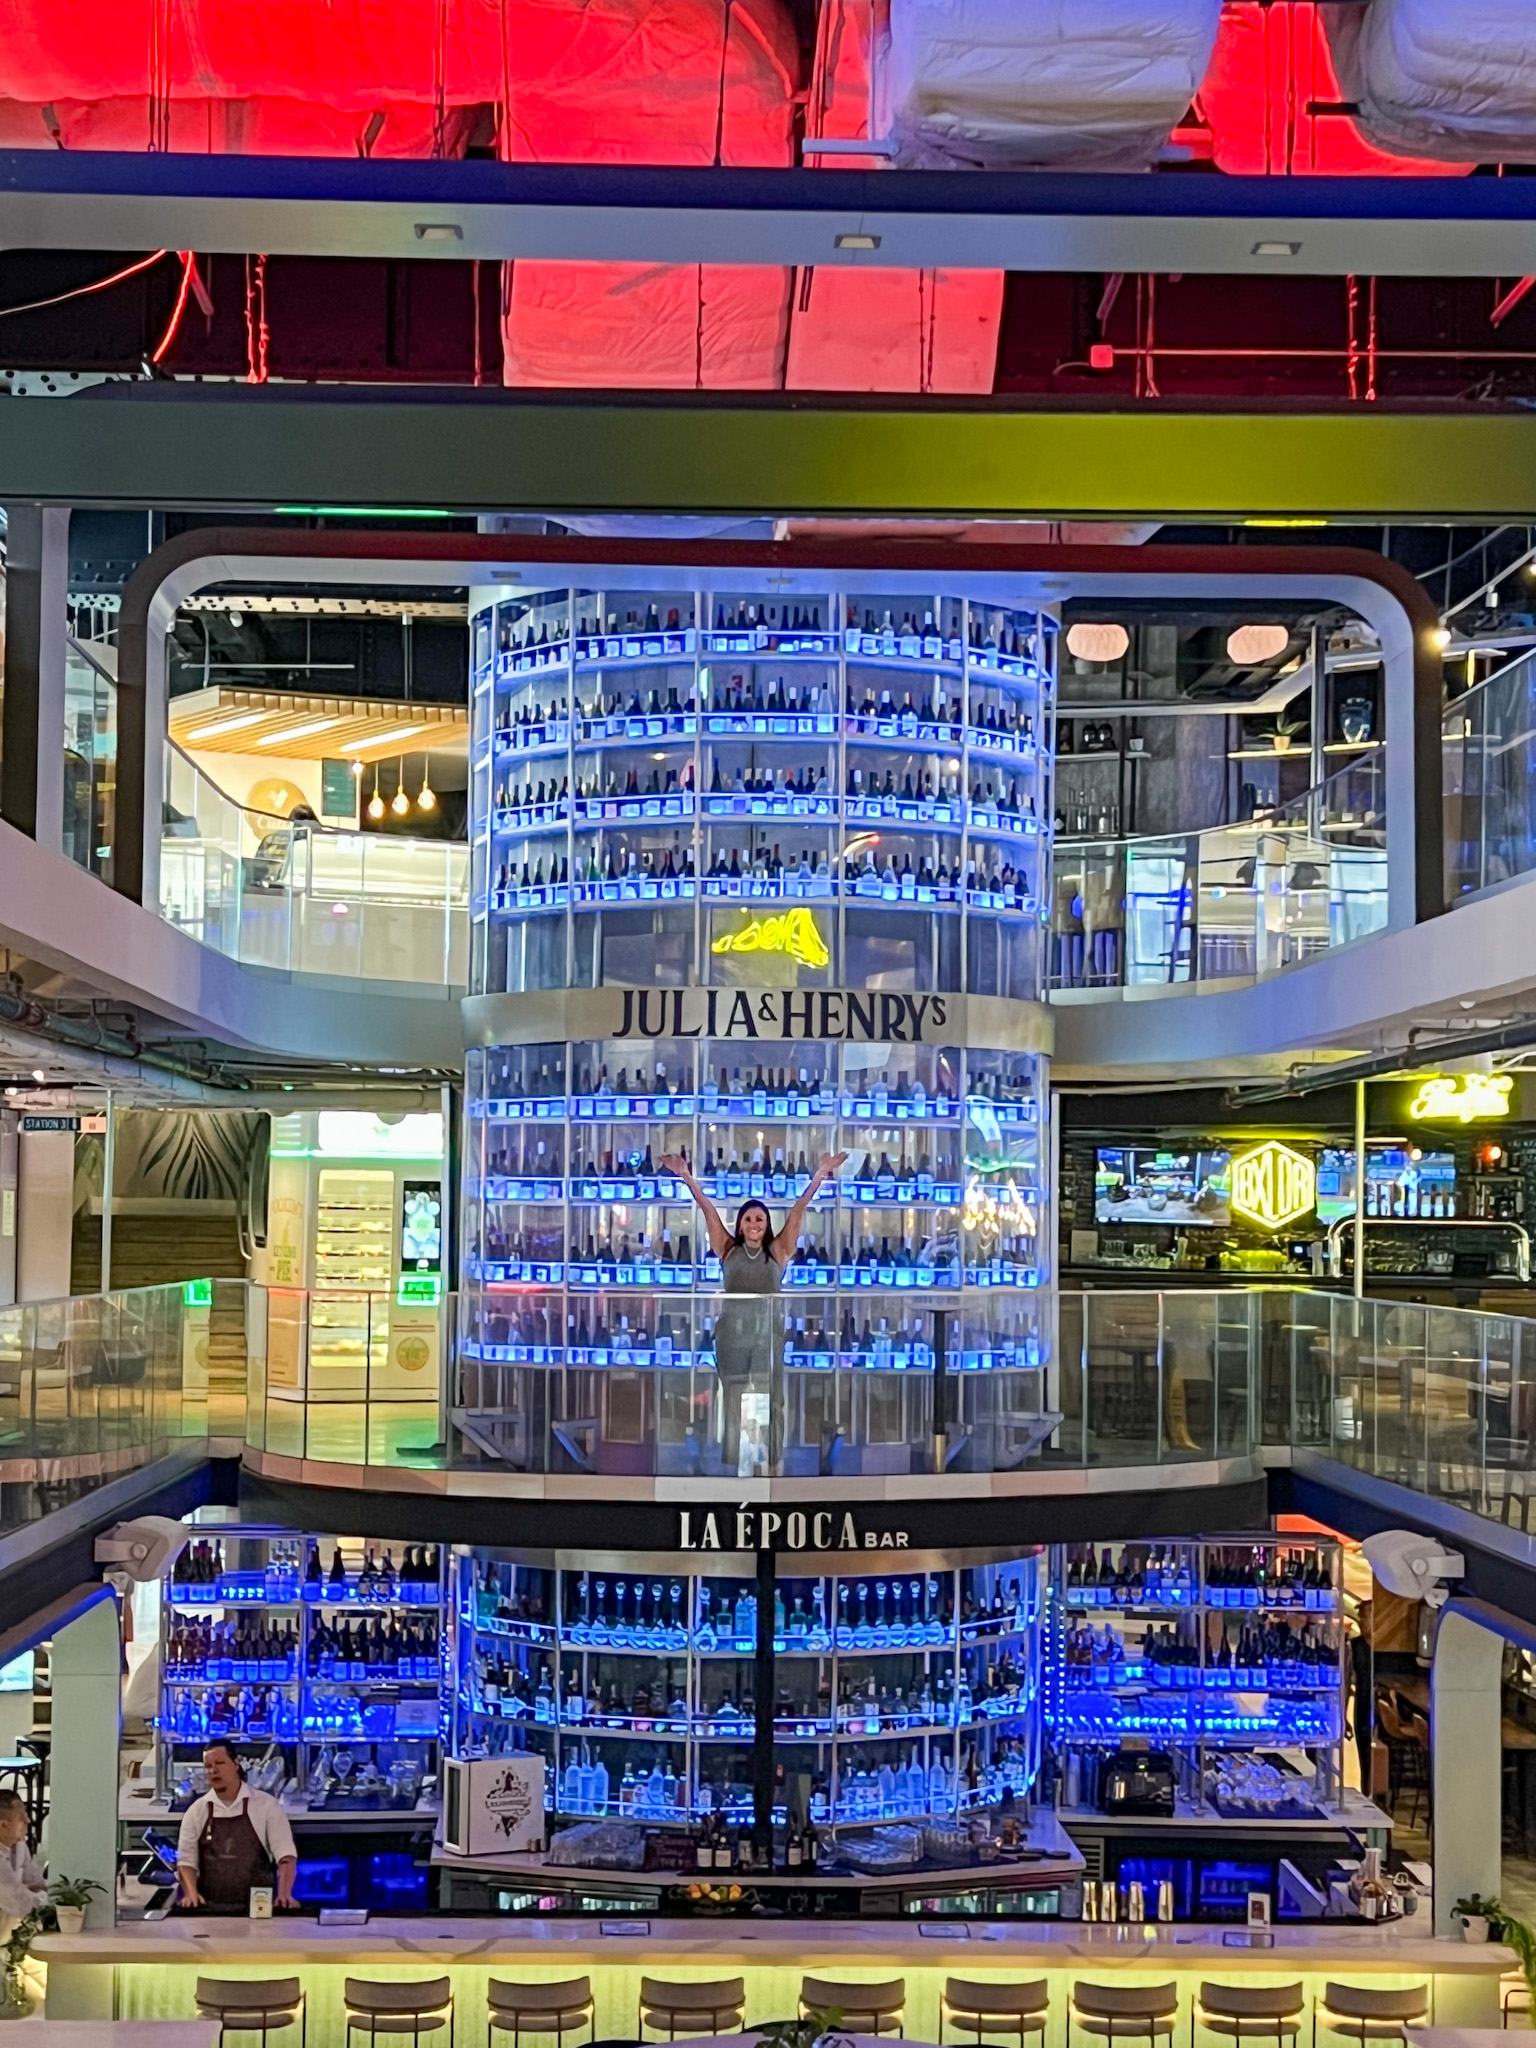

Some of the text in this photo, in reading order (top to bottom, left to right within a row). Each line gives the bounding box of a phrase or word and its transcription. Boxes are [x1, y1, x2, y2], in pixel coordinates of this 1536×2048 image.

[25, 1118, 59, 1129] STATION
[679, 1500, 909, 1549] LA ÉPOCA BAR
